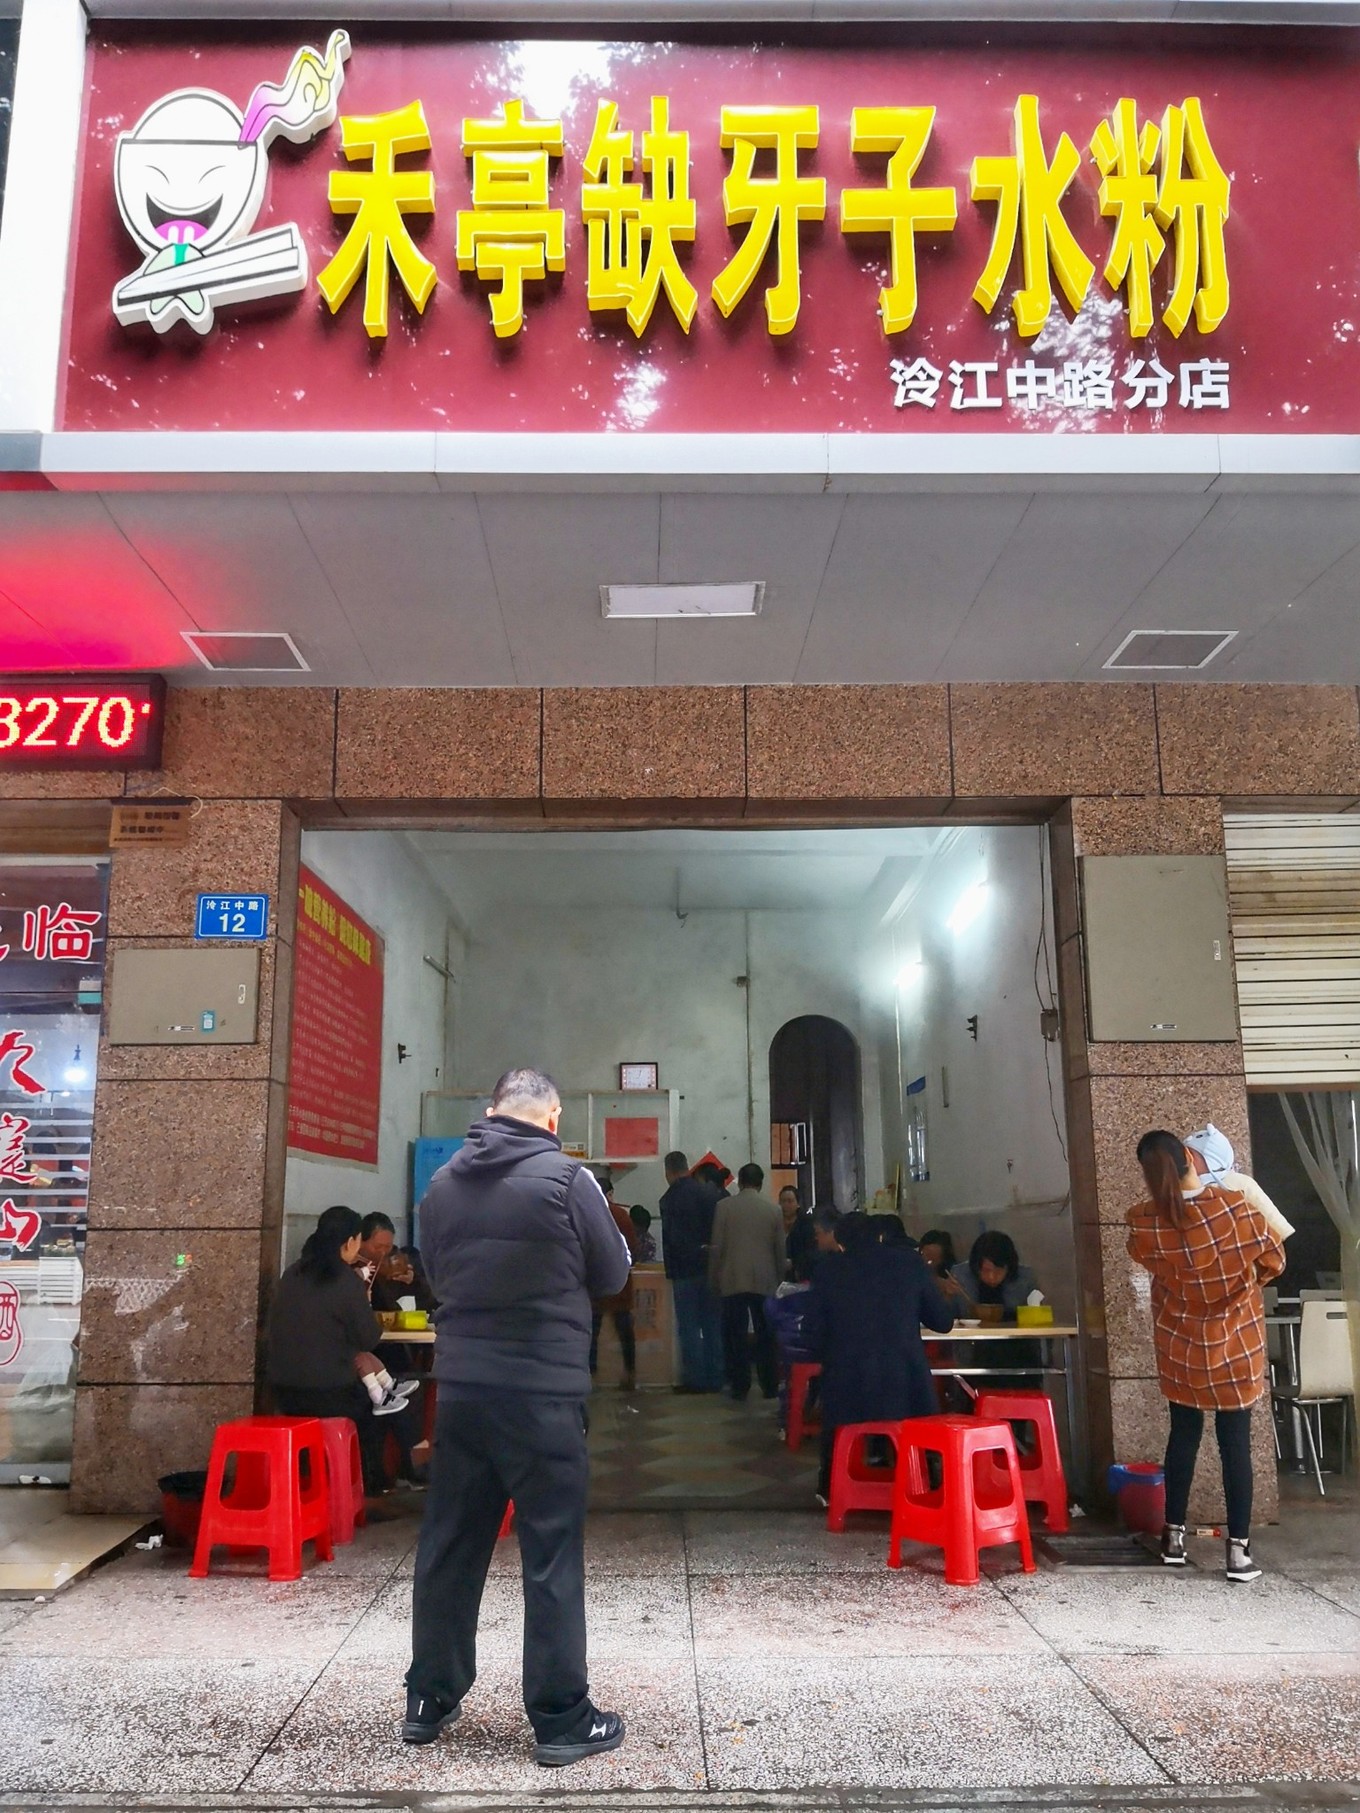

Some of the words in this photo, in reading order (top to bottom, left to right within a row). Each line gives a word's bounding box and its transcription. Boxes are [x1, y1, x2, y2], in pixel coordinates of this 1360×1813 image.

[316, 94, 1232, 339] 禾亭缺牙子水粉
[888, 357, 1231, 411] 泠江中路分店
[219, 913, 246, 933] 12
